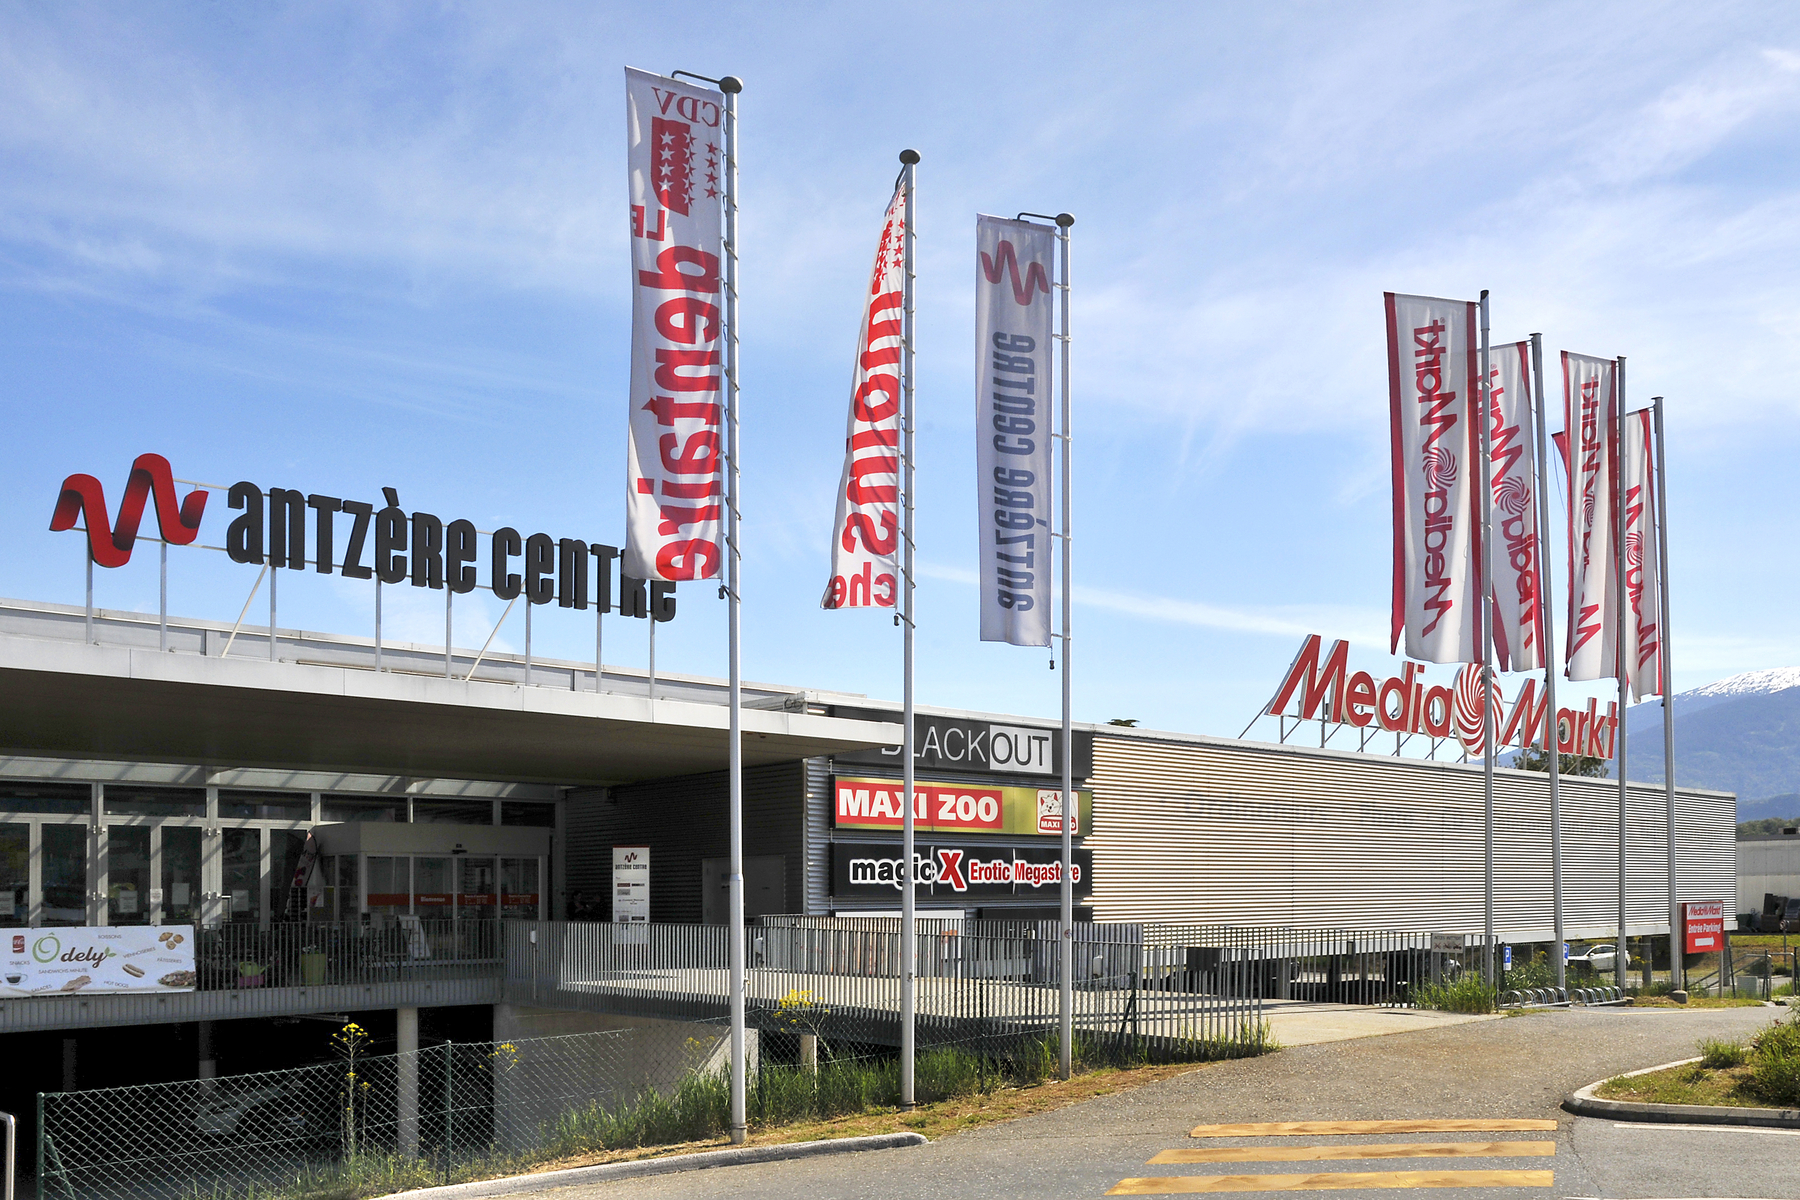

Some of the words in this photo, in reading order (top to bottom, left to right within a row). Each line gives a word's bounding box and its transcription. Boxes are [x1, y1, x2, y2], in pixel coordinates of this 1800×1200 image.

[1267, 633, 1455, 738] Media
[1500, 677, 1618, 760] Markt
[881, 725, 1052, 767] ACKOUT
[838, 788, 927, 819] MAXI
[938, 794, 999, 822] ZOO
[1040, 820, 1060, 828] MAXI
[970, 862, 1010, 880] Erotic
[1014, 862, 1079, 885] Megastre
[1688, 924, 1703, 934] Entrée
[1703, 922, 1721, 934] Parking
